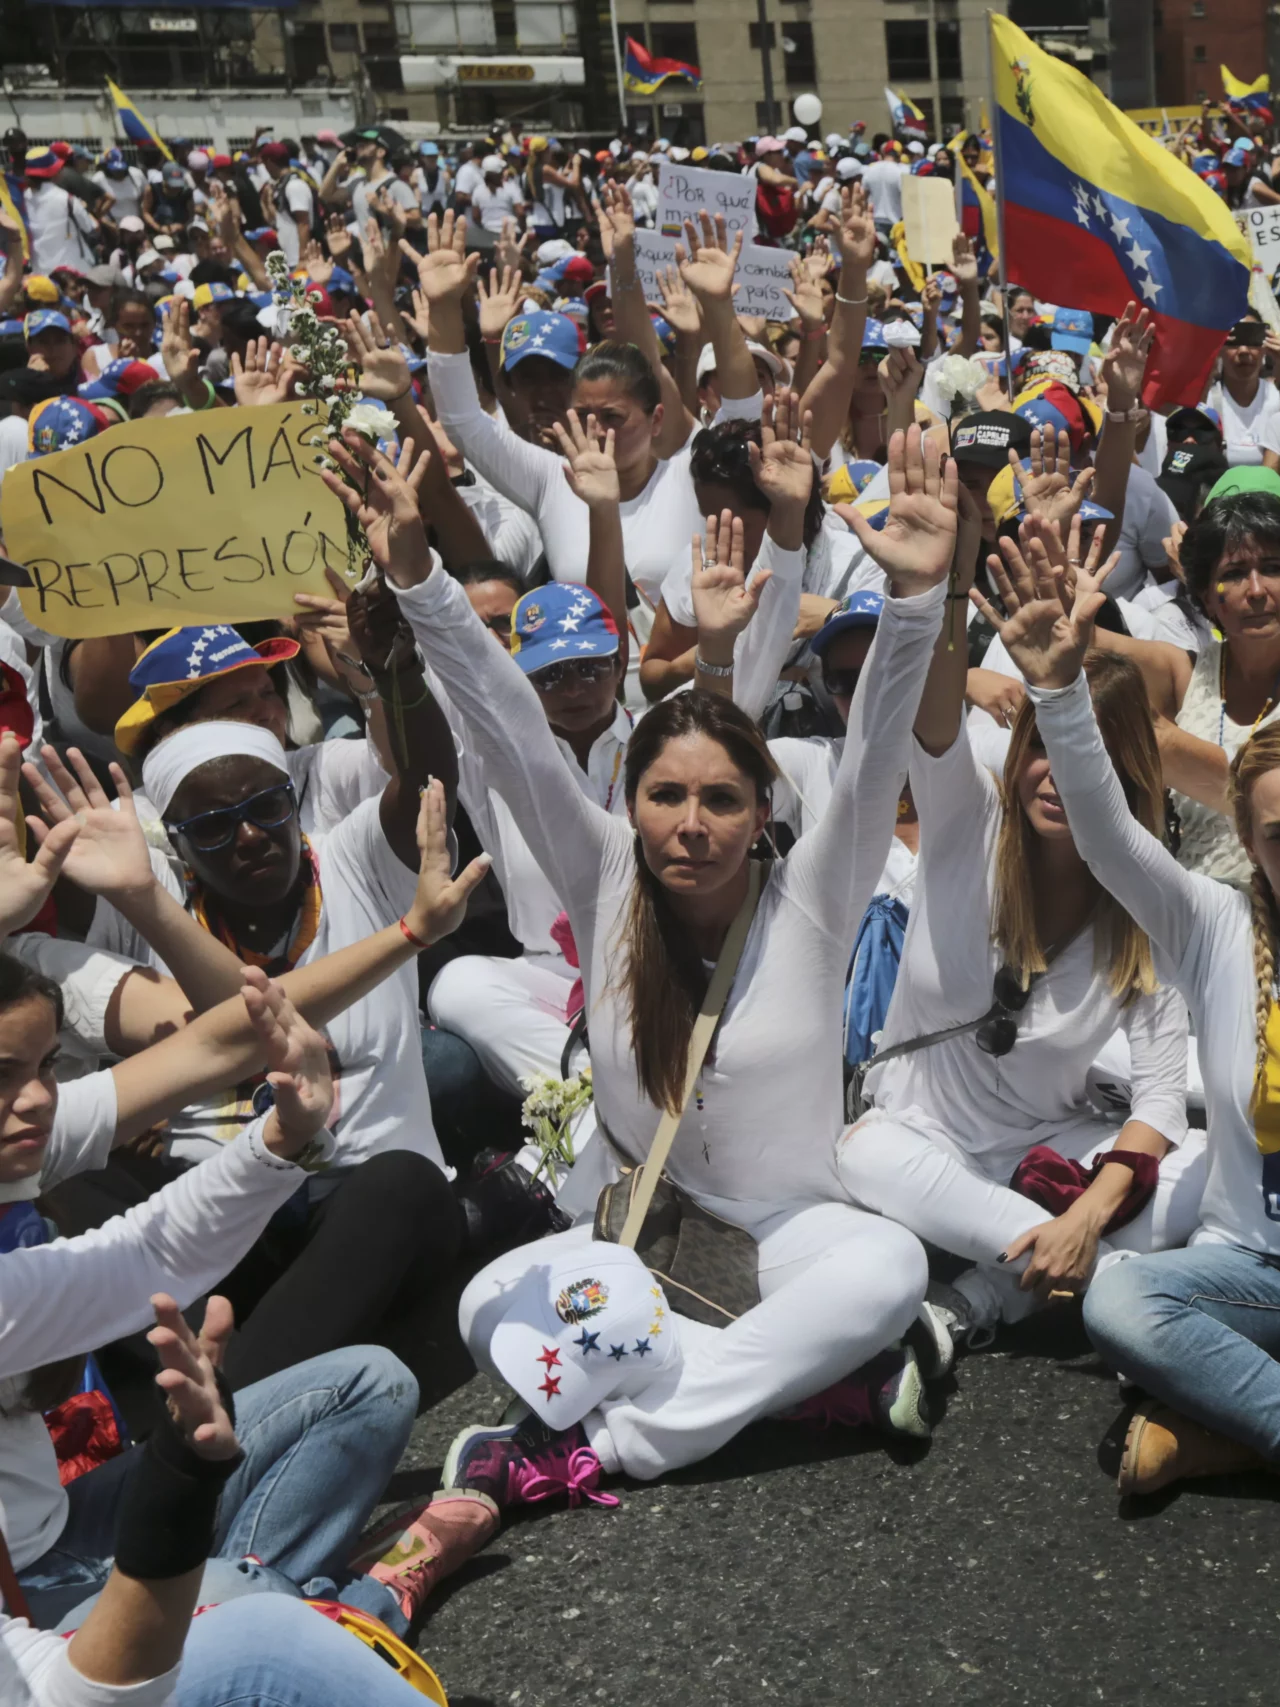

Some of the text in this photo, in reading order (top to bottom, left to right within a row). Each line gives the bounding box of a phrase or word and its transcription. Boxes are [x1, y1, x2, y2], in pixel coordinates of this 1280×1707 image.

[745, 283, 781, 304] país
[196, 413, 330, 495] MÁS
[977, 430, 1009, 441] CAPRILES
[32, 445, 165, 525] NO
[23, 512, 355, 613] REPRESIÓN
